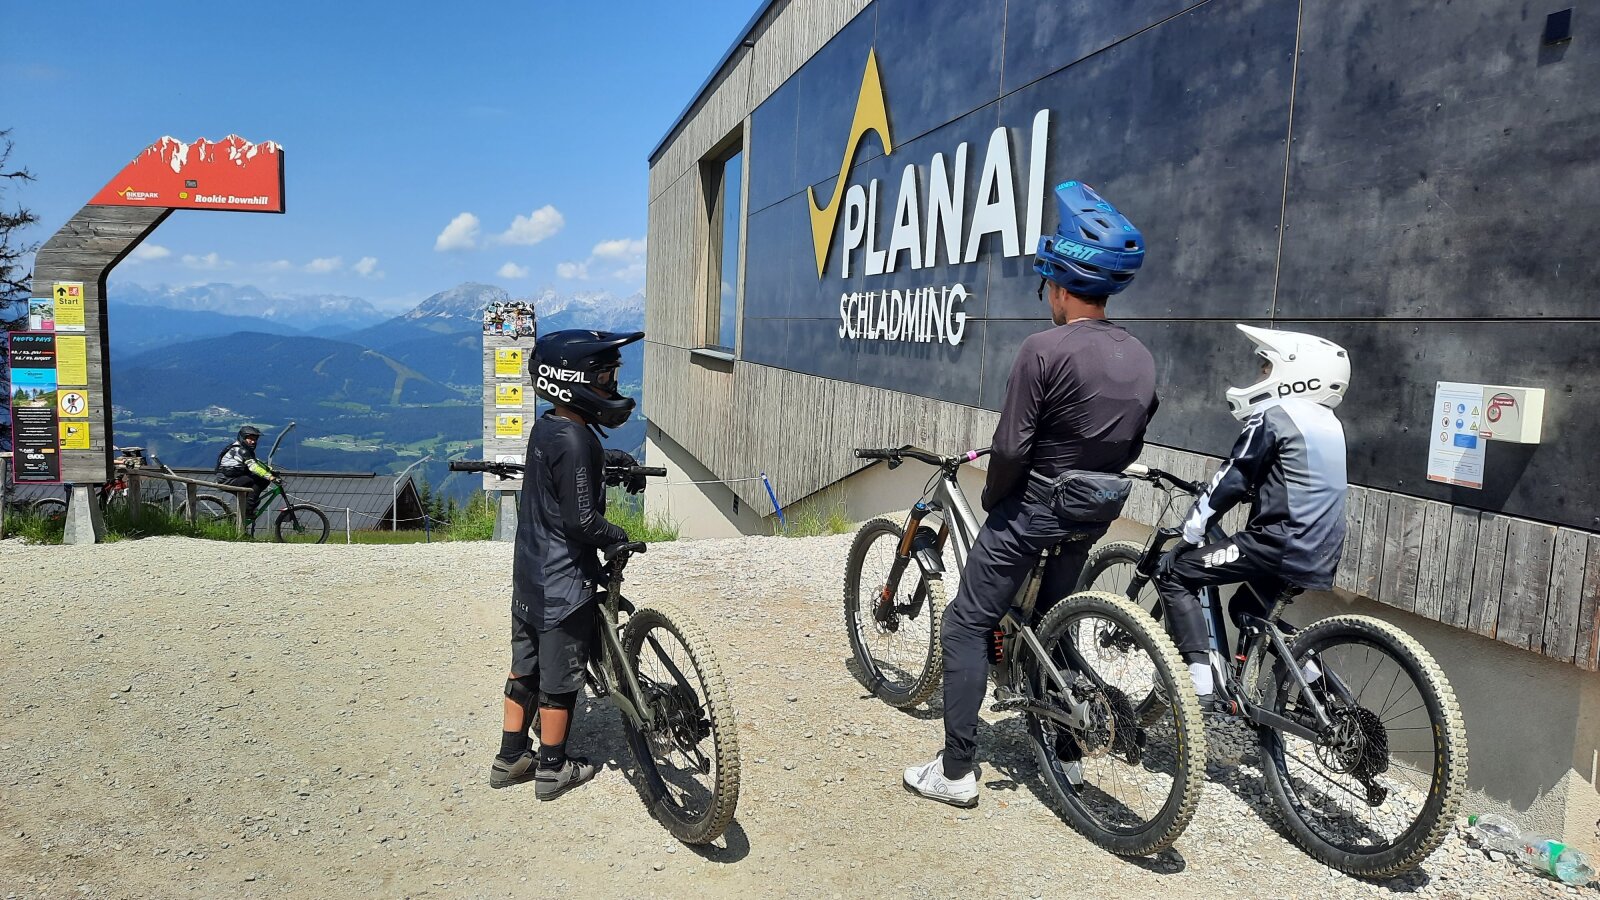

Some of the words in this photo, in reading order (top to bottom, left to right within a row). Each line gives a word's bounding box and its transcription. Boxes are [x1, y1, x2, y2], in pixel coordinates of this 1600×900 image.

[195, 194, 226, 204] Rookie
[228, 195, 269, 205] Downhill
[841, 108, 1050, 279] PLANAI
[1054, 238, 1104, 261] LEATT
[59, 297, 79, 305] Start
[838, 283, 967, 346] SCHLADMING
[575, 466, 590, 494] ENDS
